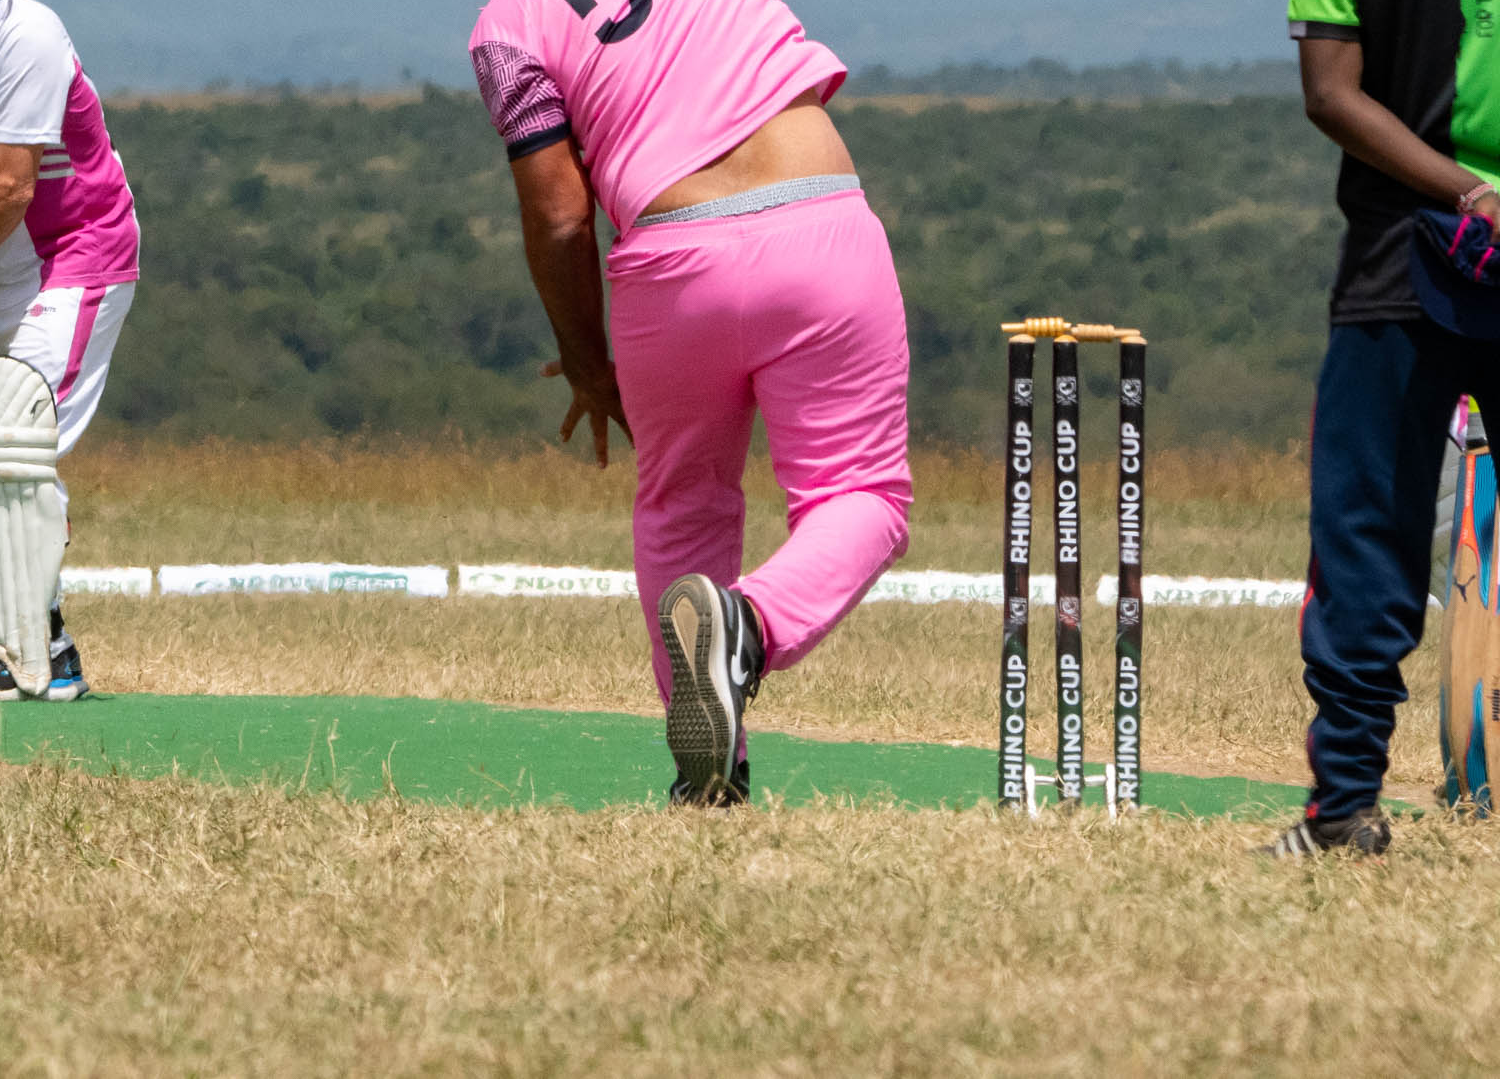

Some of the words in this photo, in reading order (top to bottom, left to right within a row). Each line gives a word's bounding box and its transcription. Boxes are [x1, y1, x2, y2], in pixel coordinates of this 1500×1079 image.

[1012, 421, 1032, 474] CUP
[1056, 419, 1076, 473] CUP
[1120, 422, 1140, 473] CUP
[1010, 480, 1031, 563] RHINO
[1058, 480, 1078, 562] RHINO
[1120, 482, 1141, 565] RHINO
[515, 576, 611, 593] NDOVU
[1005, 654, 1026, 708] CUP
[1060, 653, 1080, 706] CUP
[1118, 656, 1139, 708] CUP
[1004, 714, 1024, 798] RHINO
[1062, 713, 1081, 798] RHINO
[1117, 714, 1138, 798] RHINO
